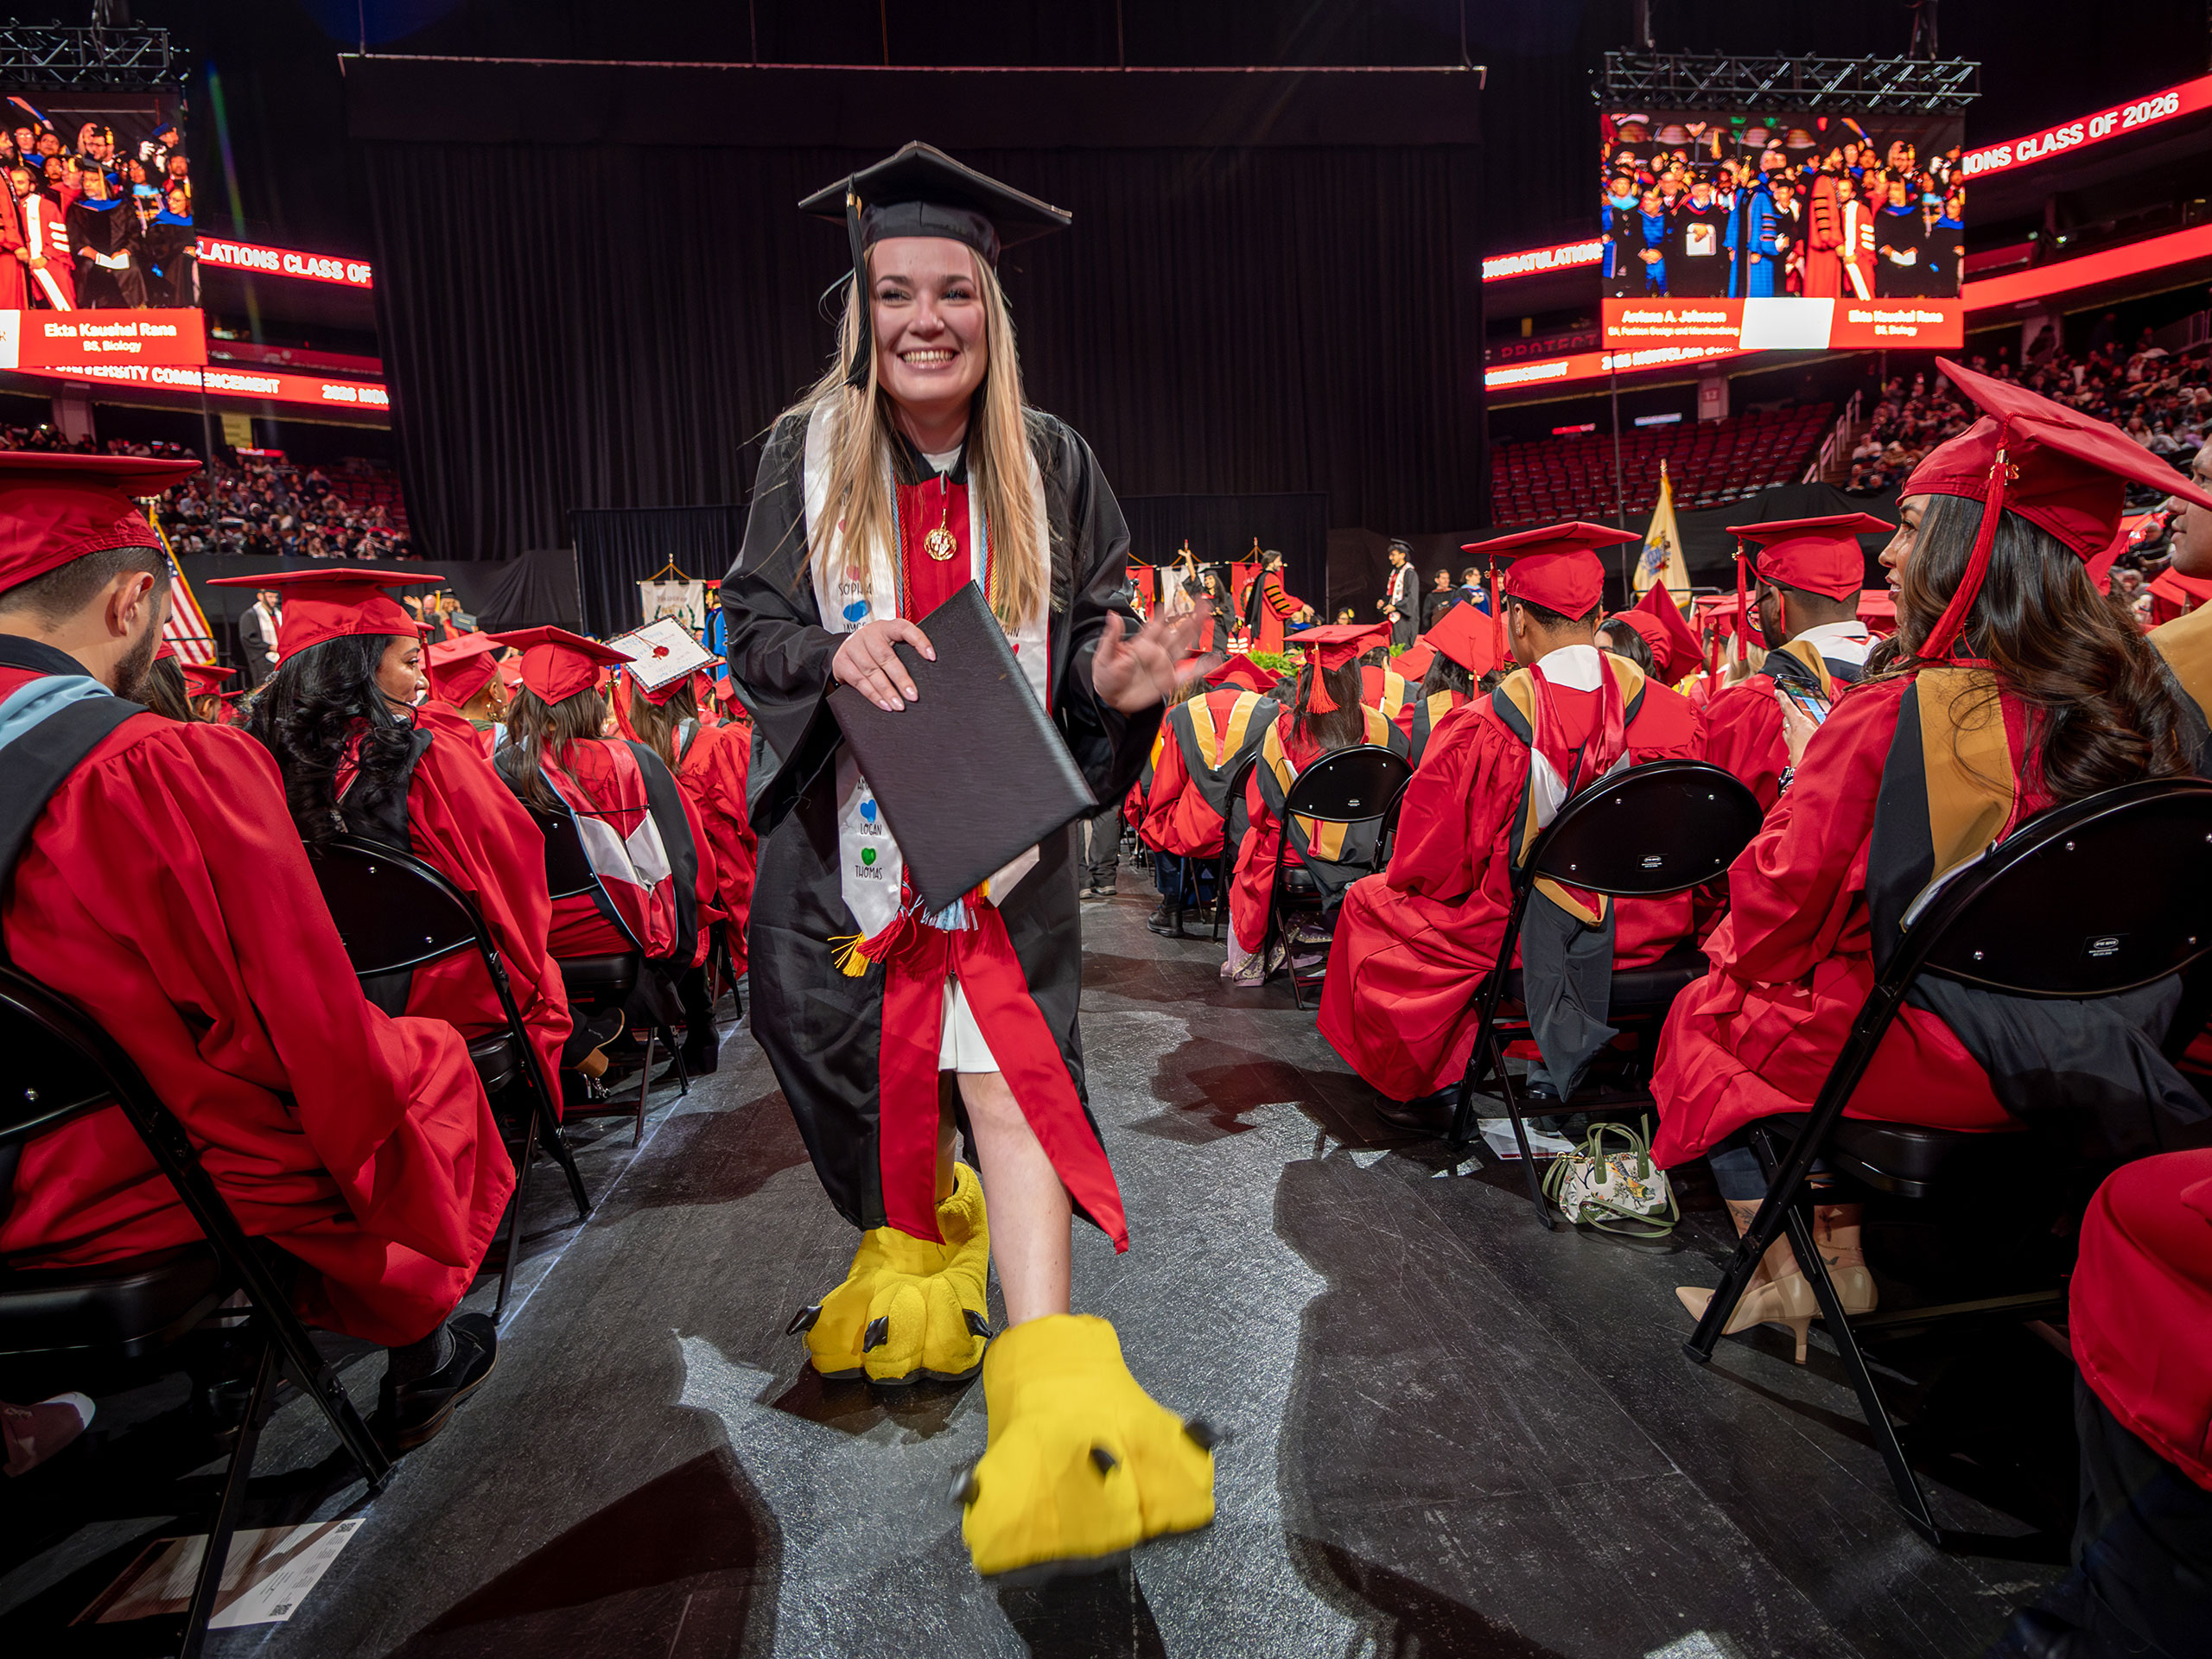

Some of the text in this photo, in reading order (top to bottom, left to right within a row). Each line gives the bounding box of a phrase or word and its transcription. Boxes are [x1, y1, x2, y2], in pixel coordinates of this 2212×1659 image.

[2016, 124, 2084, 162] CLASS
[2088, 111, 2118, 138] OF
[2122, 92, 2178, 128] 2026
[283, 253, 344, 280] CLASS
[346, 264, 372, 283] OF
[44, 322, 177, 337] Ekta Kaushal Rana
[83, 340, 142, 353] BS, Biology
[838, 582, 872, 596] SOPHA
[860, 823, 881, 836] LOGAN
[855, 865, 882, 880] THOMAS
